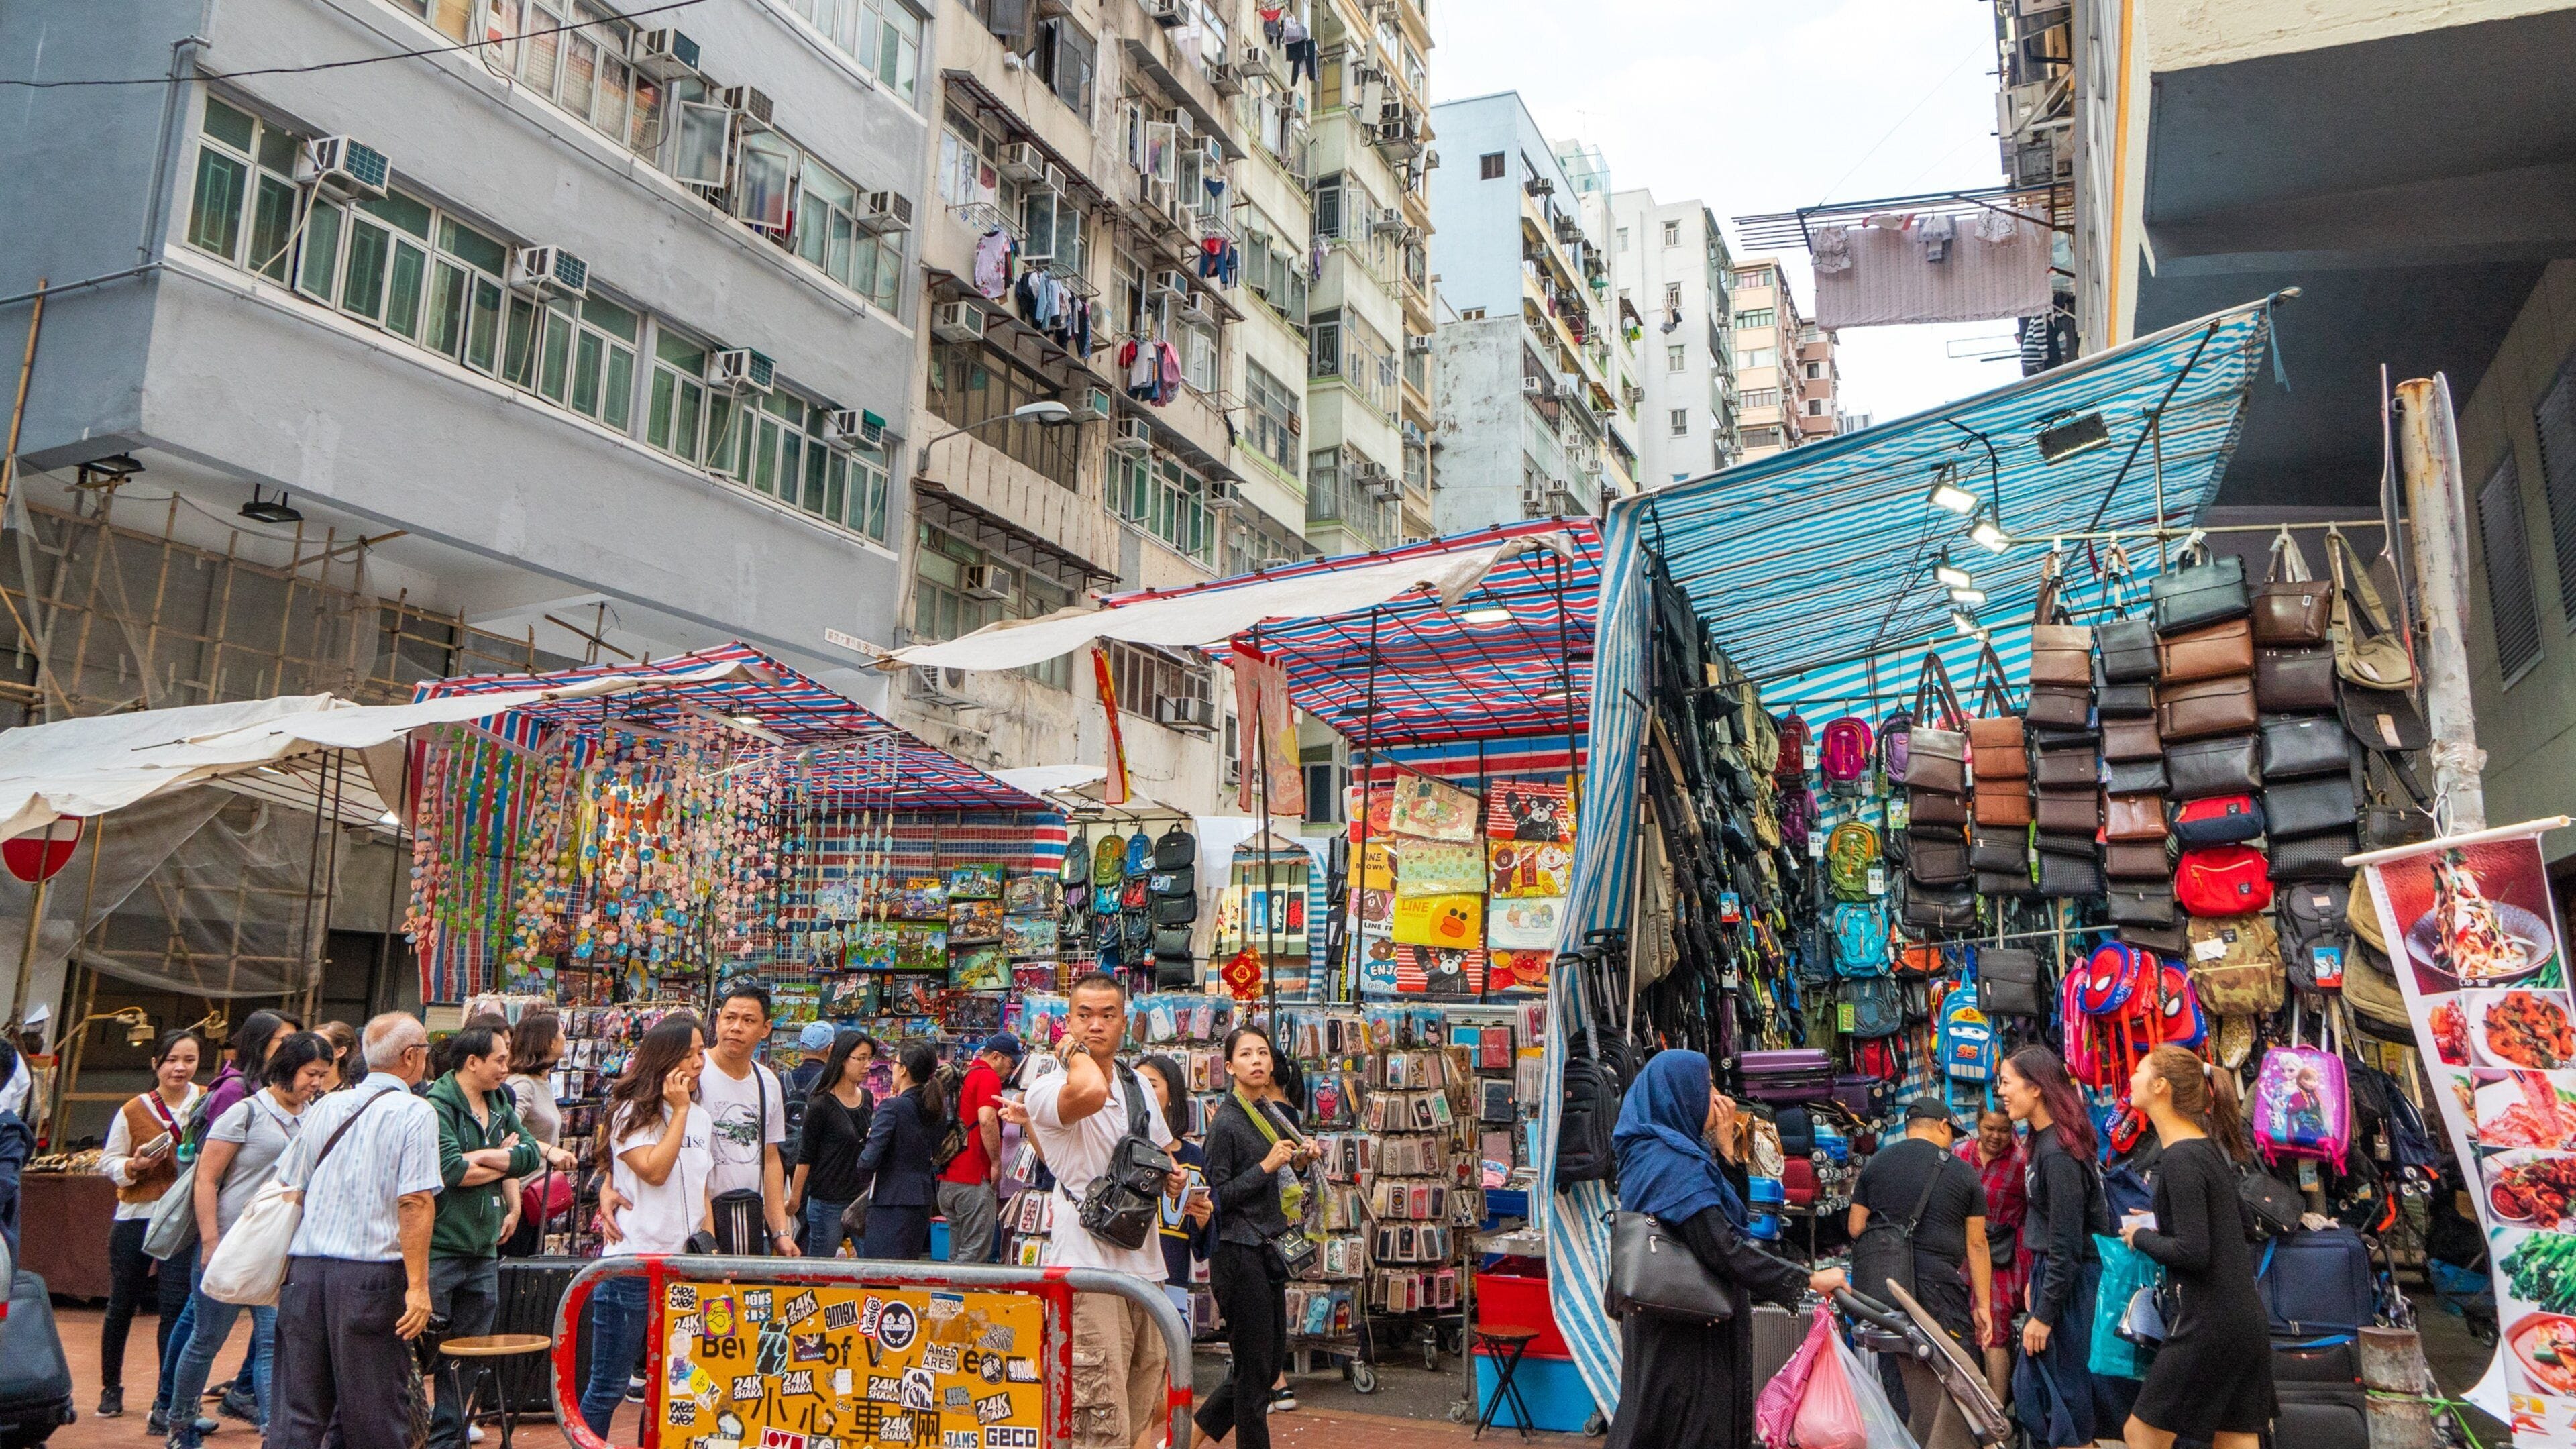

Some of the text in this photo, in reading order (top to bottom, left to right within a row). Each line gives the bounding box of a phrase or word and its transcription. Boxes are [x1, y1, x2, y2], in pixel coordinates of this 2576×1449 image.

[1355, 863, 1385, 871] BOWN
[1401, 900, 1430, 912] LINE
[1956, 1044, 1978, 1059] 95
[786, 1290, 816, 1317] 24K
[790, 1303, 819, 1326] SHAKA
[674, 1313, 700, 1332] 24K
[881, 1324, 912, 1332] UNCHAINED
[824, 1335, 853, 1366] of
[927, 1342, 957, 1357] ARES
[922, 1356, 952, 1370] ARES
[733, 1375, 763, 1391] 24K
[783, 1370, 812, 1385] 24K
[869, 1376, 900, 1393] 24K
[733, 1389, 764, 1400] SHAKA
[782, 1383, 813, 1395] SHAKA
[867, 1389, 901, 1403] SHAKA
[976, 1392, 1009, 1413] 24K
[881, 1416, 912, 1432] 24K
[879, 1429, 913, 1442] SHAKA
[945, 1432, 979, 1449] JAMS
